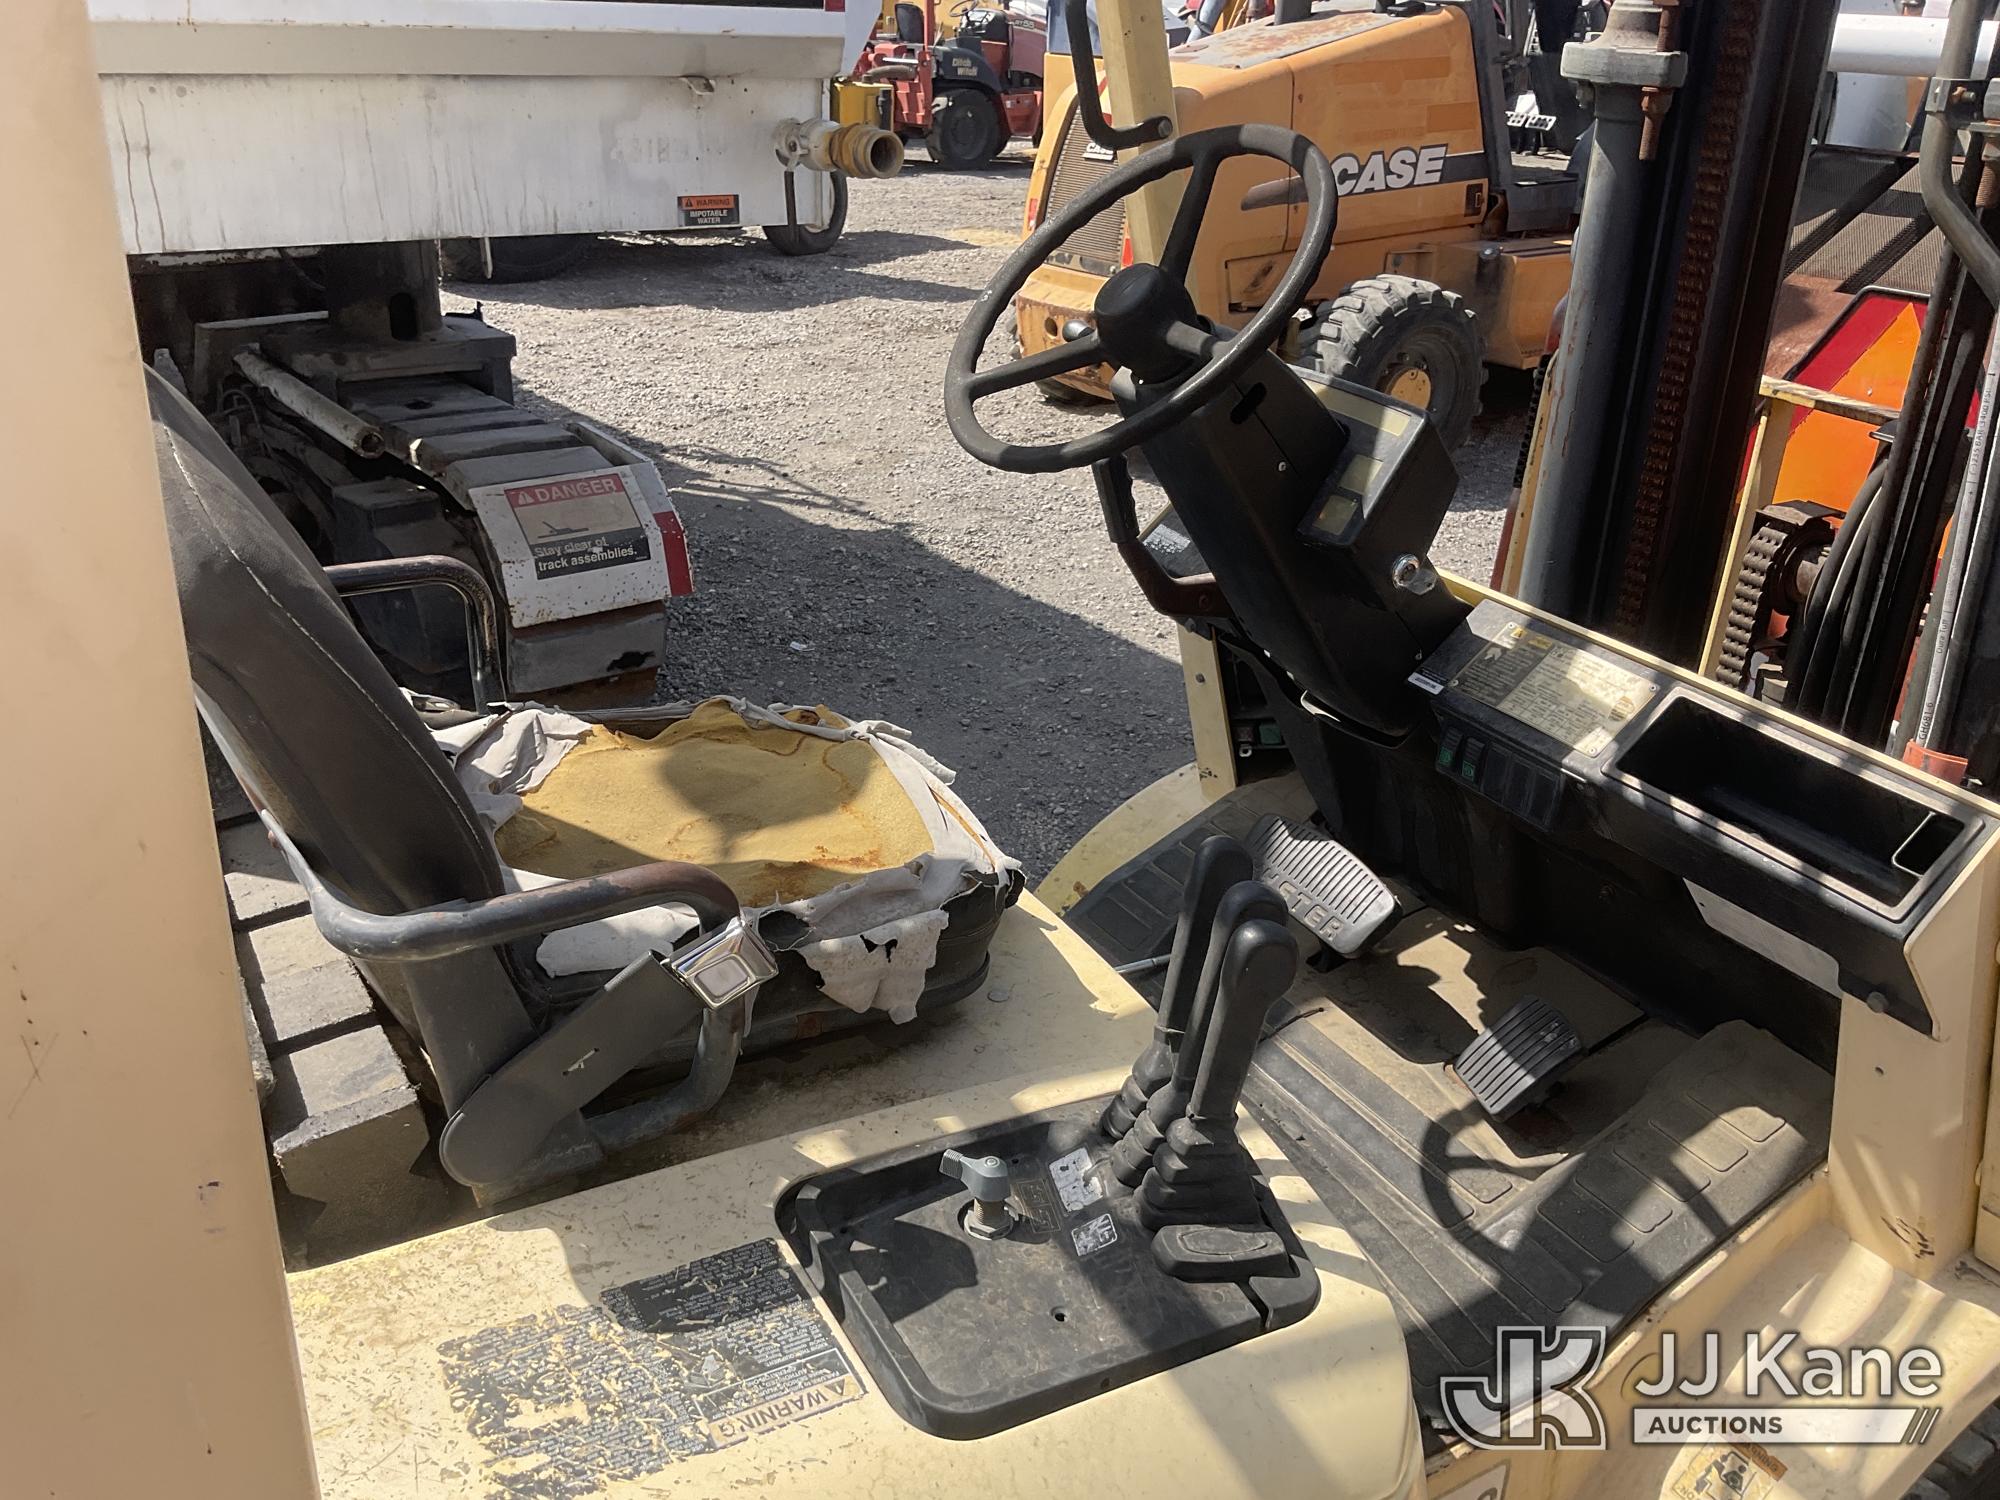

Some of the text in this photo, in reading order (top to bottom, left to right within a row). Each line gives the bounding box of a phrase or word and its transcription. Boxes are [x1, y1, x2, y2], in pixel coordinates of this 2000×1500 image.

[1330, 144, 1448, 196] CASE
[696, 198, 730, 207] WARNING
[697, 217, 721, 225] WATER
[534, 478, 617, 502] DANGER
[533, 535, 609, 557] Stay clear of
[538, 545, 638, 571] track assemblies.
[718, 1387, 829, 1438] WARNING
